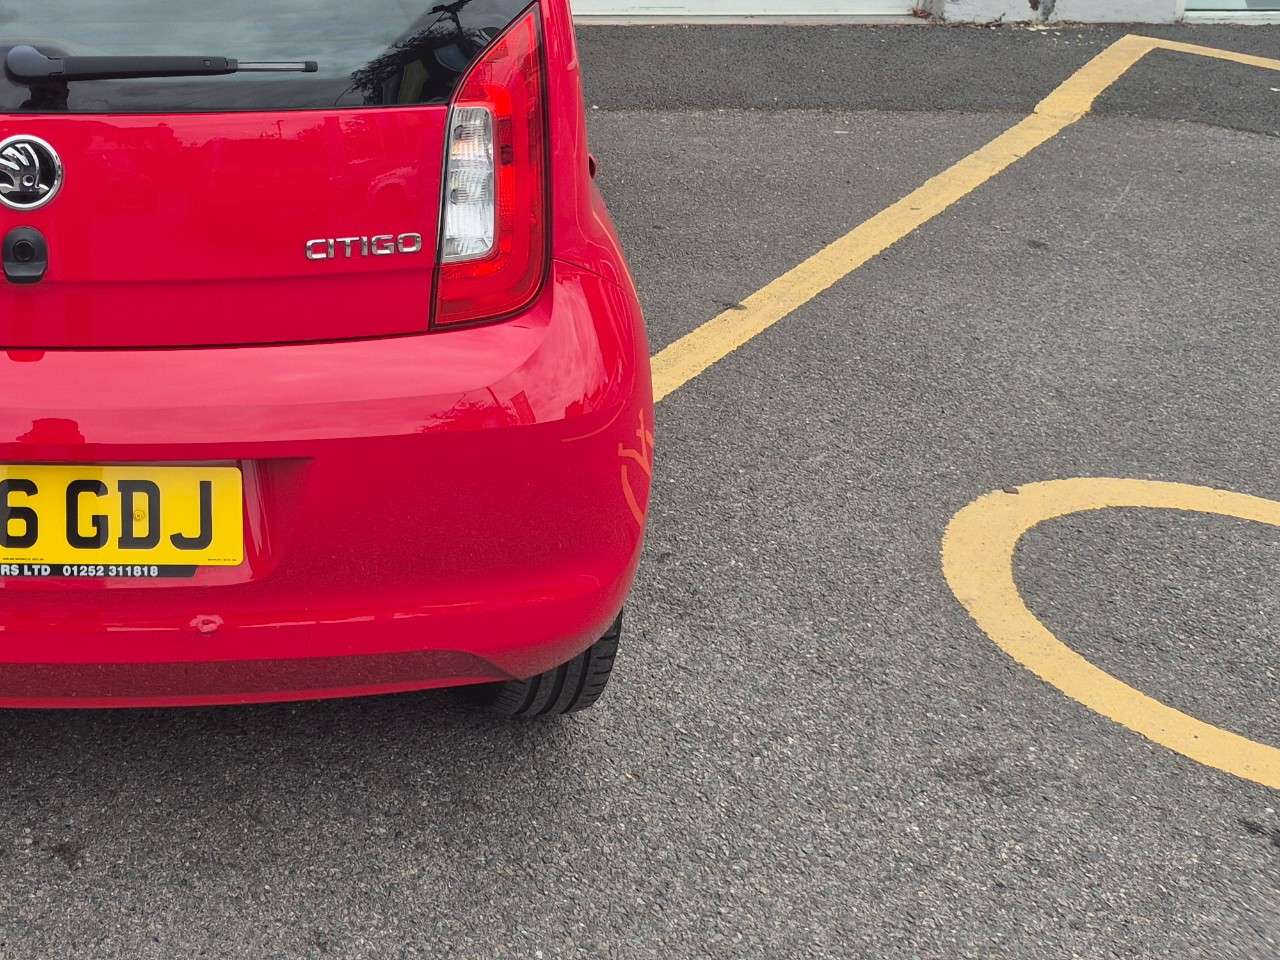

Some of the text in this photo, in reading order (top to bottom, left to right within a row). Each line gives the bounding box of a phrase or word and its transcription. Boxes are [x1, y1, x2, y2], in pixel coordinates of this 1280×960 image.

[305, 232, 423, 260] CITIGO
[66, 479, 213, 551] GDJ
[23, 564, 52, 577] LTD
[63, 565, 105, 577] 01252
[108, 565, 159, 578] 311818
